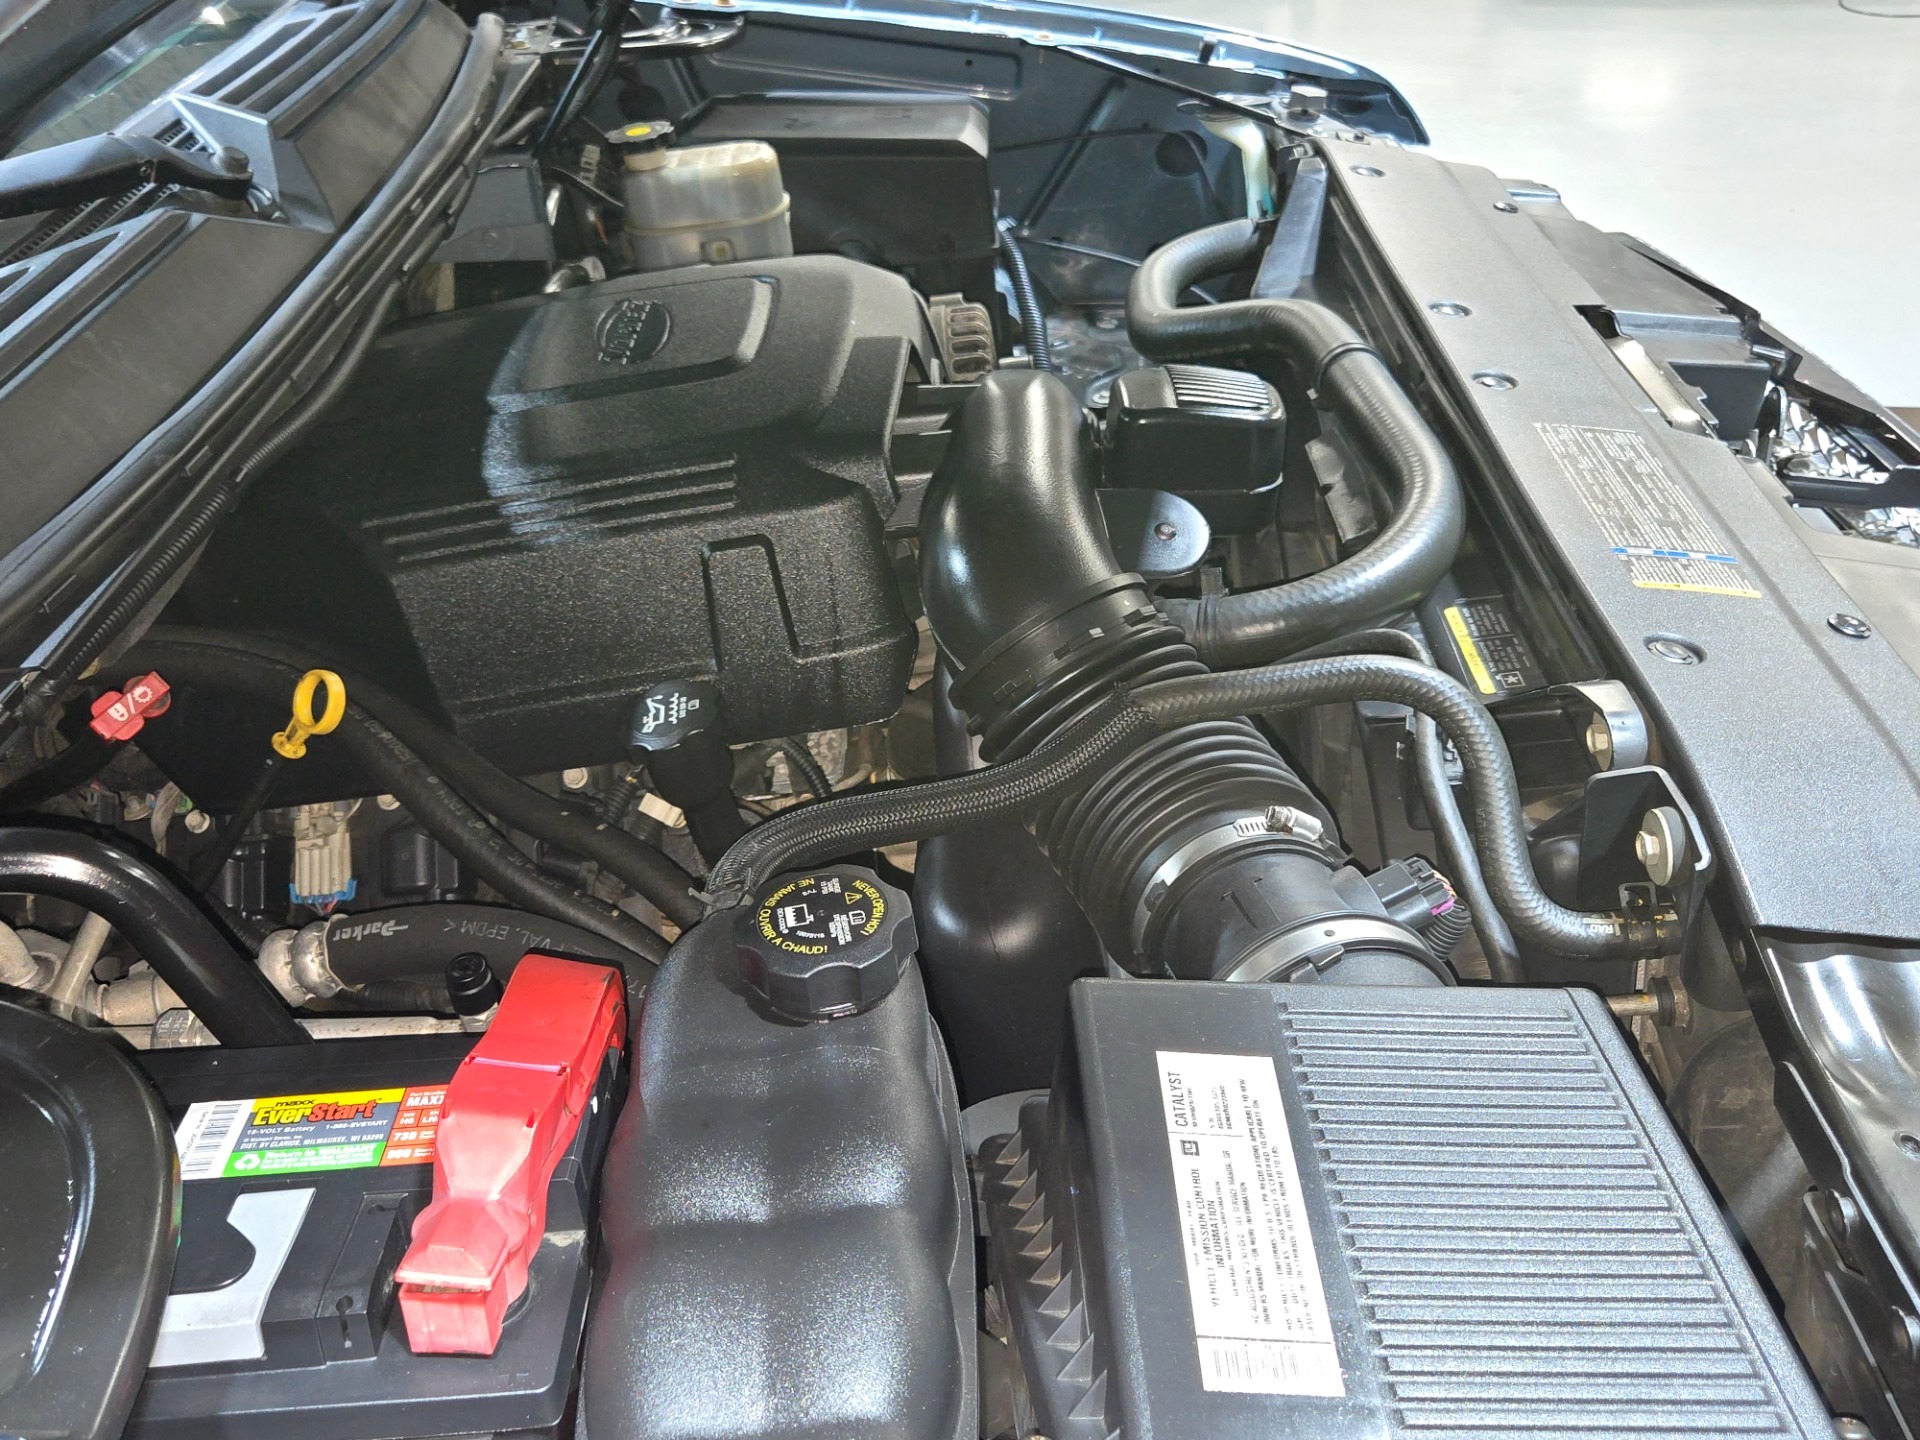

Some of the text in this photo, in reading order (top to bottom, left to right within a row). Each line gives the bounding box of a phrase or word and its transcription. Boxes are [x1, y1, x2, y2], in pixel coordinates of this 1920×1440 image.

[765, 883, 796, 907] JAMAIS
[797, 877, 815, 888] NE
[852, 880, 885, 936] NEVER OPEN HOT!
[332, 919, 409, 941] Parker
[759, 908, 777, 941] OUVRIR
[1589, 924, 1614, 934] RAD
[782, 941, 828, 955] CHAUD!
[1167, 1071, 1188, 1127] CATALYST
[1239, 1079, 1247, 1093] NEW
[251, 1100, 376, 1126] EverStart
[275, 1099, 316, 1108] maxx
[1253, 1100, 1260, 1108] ON
[246, 1125, 316, 1136] 12-VOLT Battery
[1244, 1106, 1257, 1142] APPLICABLE
[1254, 1112, 1266, 1139] OPERATE
[1252, 1145, 1266, 1190] REGULATIONS
[1263, 1152, 1275, 1186] CERTIFIED
[1215, 1181, 1227, 1228] CORPORATION
[1240, 1182, 1253, 1225] INFORMATION
[1191, 1169, 1219, 1307] VEHICLE EMISSION CONTROL
[1207, 1200, 1225, 1268] INFORMATION
